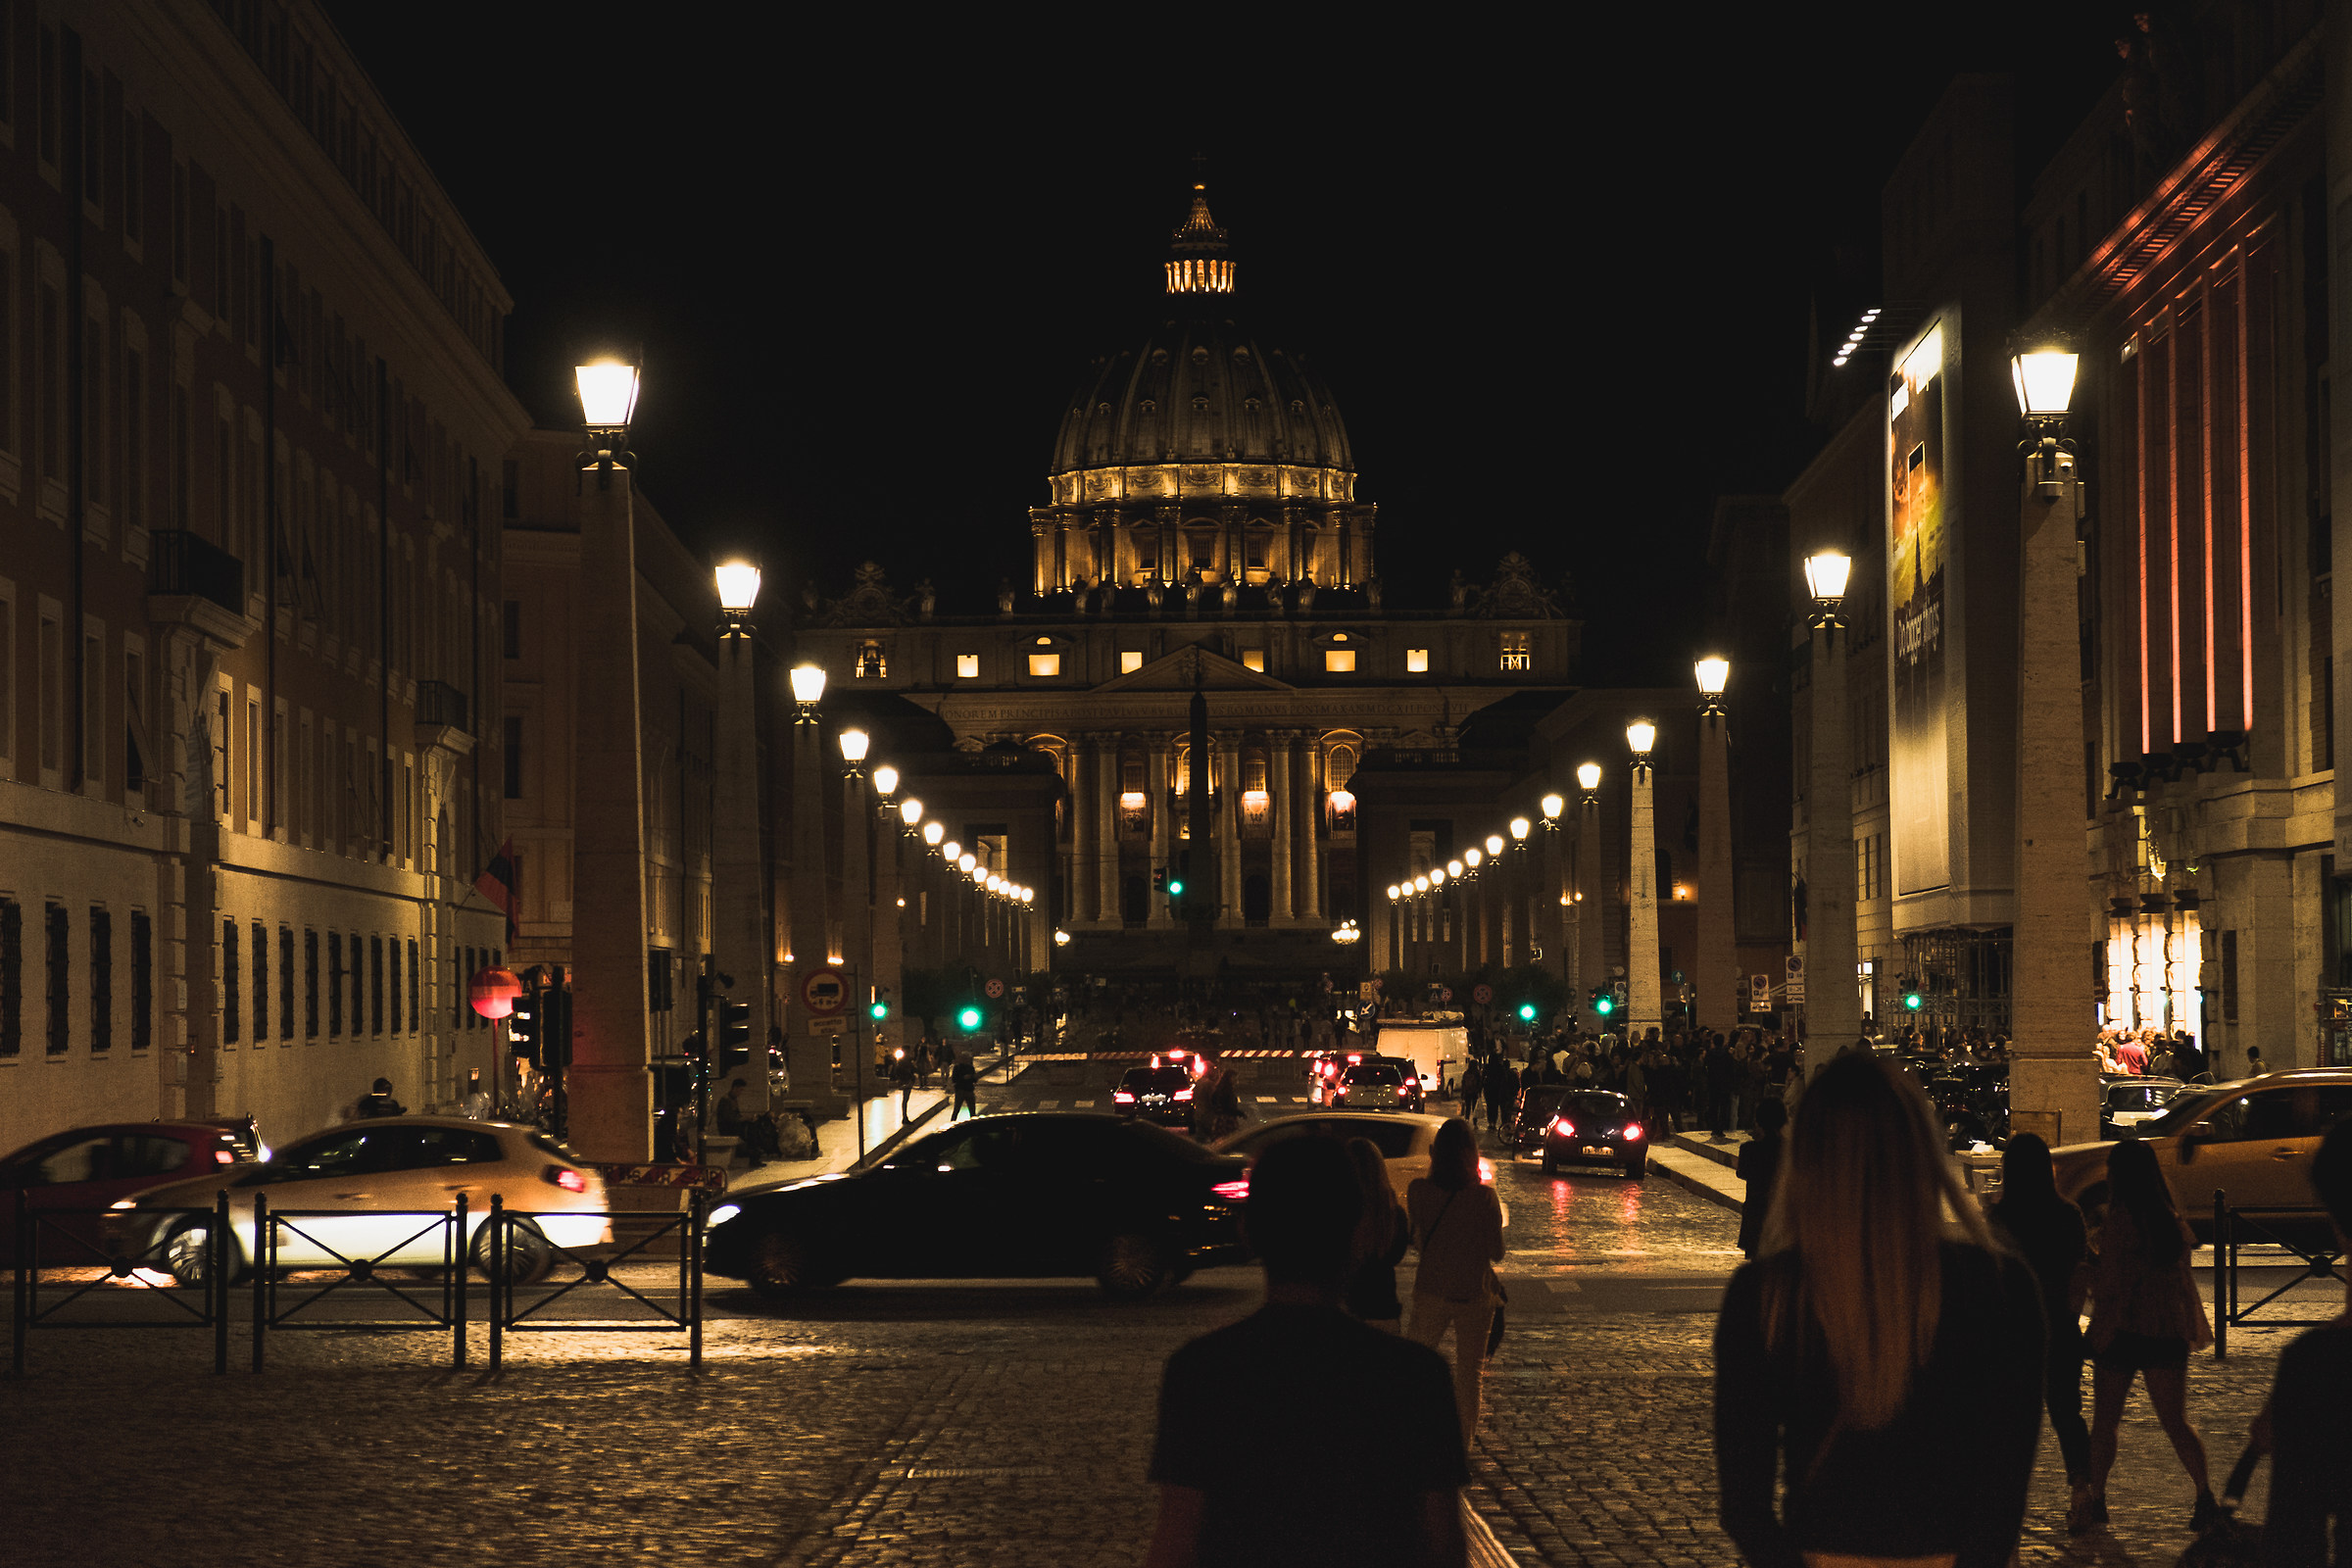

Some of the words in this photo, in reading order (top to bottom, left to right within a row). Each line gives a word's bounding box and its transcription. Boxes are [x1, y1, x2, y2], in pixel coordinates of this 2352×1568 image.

[1001, 709, 1059, 718] PRINCIPIS
[1227, 705, 1287, 715] ROMANVS
[1417, 704, 1443, 713] PON
